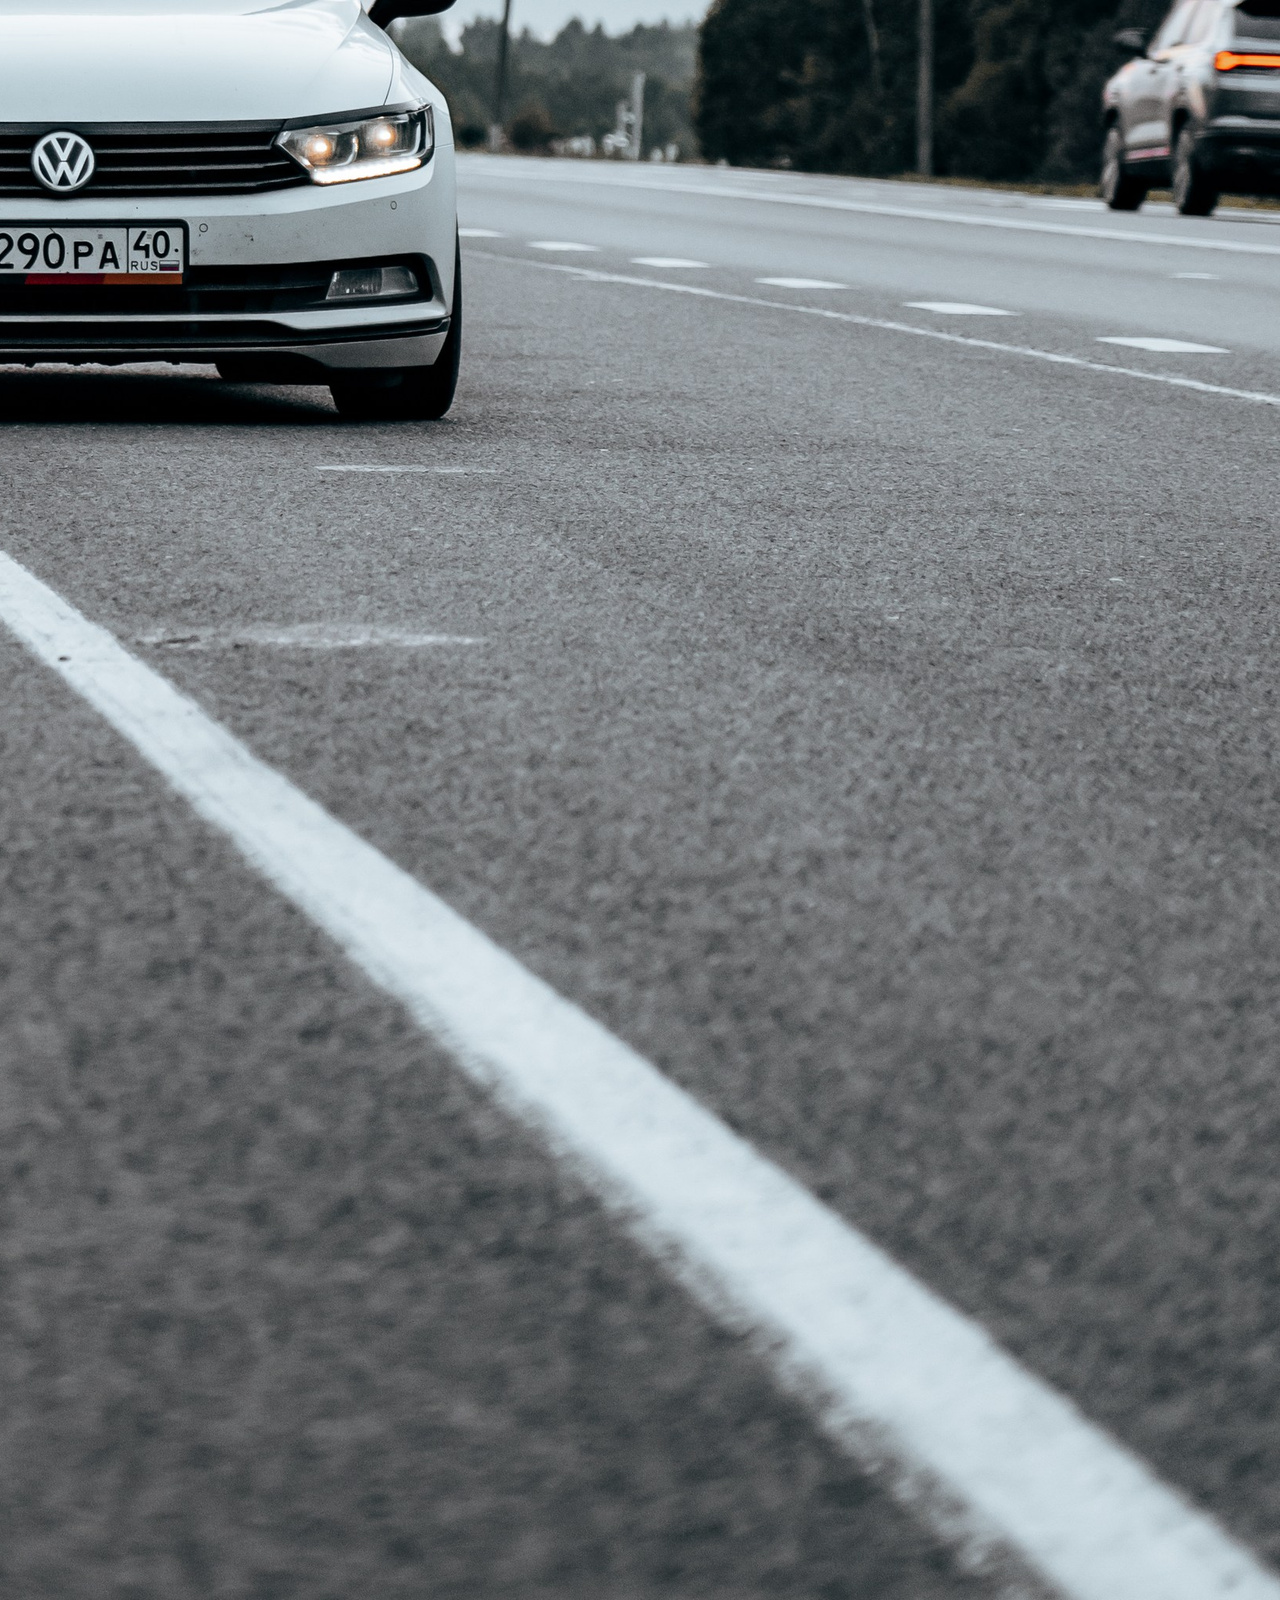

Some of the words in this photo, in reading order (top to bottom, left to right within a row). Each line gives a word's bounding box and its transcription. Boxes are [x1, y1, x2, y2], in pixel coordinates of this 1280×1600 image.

[35, 133, 92, 188] VW
[133, 230, 170, 258] 40
[130, 260, 158, 271] RUS
